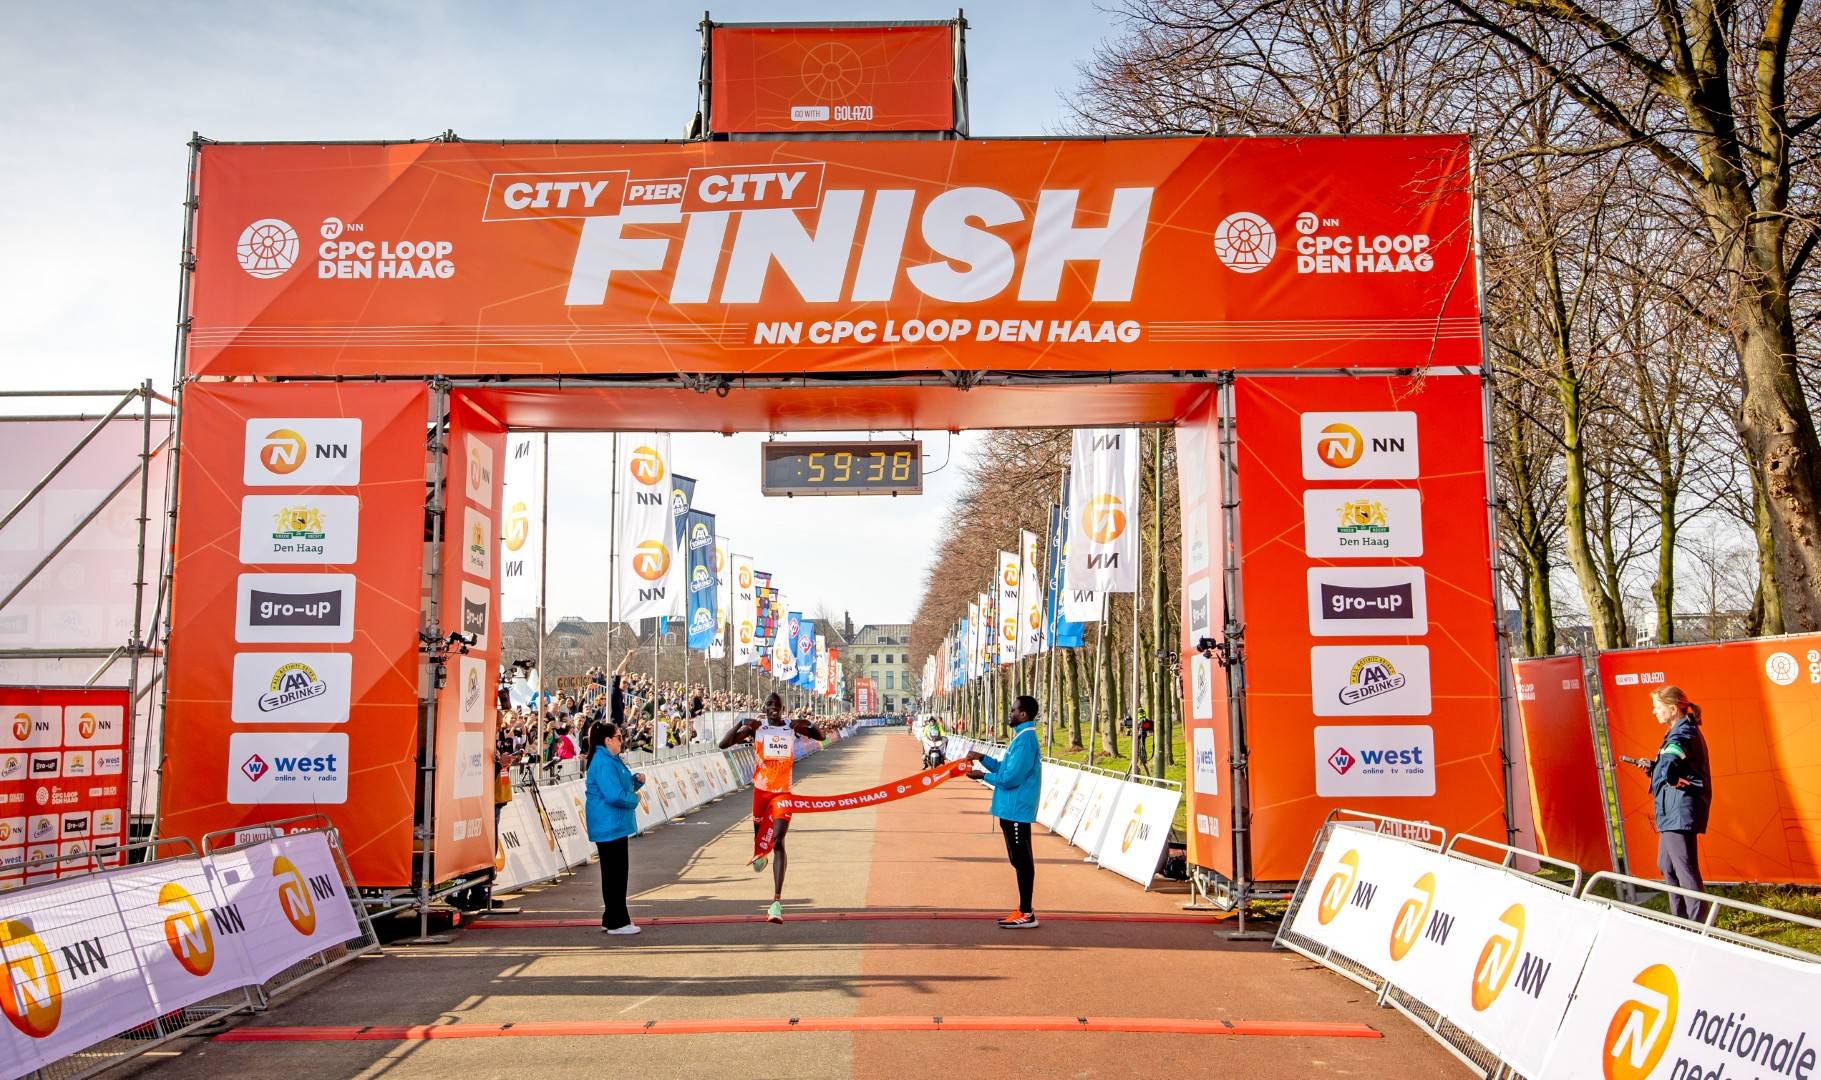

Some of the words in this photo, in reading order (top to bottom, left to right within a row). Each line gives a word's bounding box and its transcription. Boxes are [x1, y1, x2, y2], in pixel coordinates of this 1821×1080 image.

[834, 105, 873, 121] GOLAZO
[503, 180, 609, 211] CITY
[629, 184, 682, 201] PIER
[698, 171, 807, 203] CITY
[347, 223, 364, 232] NN
[1322, 218, 1339, 227] NN
[319, 241, 376, 260] CPC
[381, 241, 453, 260] LOOP
[564, 186, 1154, 305] FINISH
[1296, 236, 1353, 255] CPC
[1358, 235, 1430, 254] LOOP
[318, 260, 372, 279] DEN
[378, 260, 456, 279] HAAG
[1297, 255, 1351, 274] DEN
[1356, 253, 1434, 272] HAAG
[753, 321, 804, 345] NN
[809, 320, 877, 345] CPC
[882, 320, 972, 345] LOOP
[977, 320, 1045, 345] DEN
[1047, 320, 1142, 345] HAAG
[316, 443, 348, 459] NN
[1372, 438, 1405, 453] NN
[636, 491, 663, 505] NN
[274, 543, 294, 553] Den
[297, 543, 324, 555] Haag
[1340, 536, 1360, 546] Den
[1362, 536, 1390, 548] Haag
[640, 586, 665, 601] NN
[1005, 590, 1018, 598] NN
[260, 600, 331, 618] gro-up
[1331, 594, 1403, 612] gro-up
[285, 673, 309, 692] AA
[1364, 666, 1388, 686] AA
[280, 686, 315, 704] DRINK
[1359, 679, 1394, 697] DRINK
[36, 721, 49, 732] NN
[98, 720, 111, 730] NN
[274, 754, 337, 772] west
[1360, 746, 1422, 765] west
[275, 774, 296, 782] online
[318, 774, 338, 782] radio
[1363, 767, 1384, 775] online
[1405, 767, 1424, 775] radio
[777, 799, 792, 808] NN
[793, 800, 810, 808] CPC
[811, 800, 836, 808] LOOP
[838, 797, 858, 806] DEN
[859, 791, 888, 802] HAAG
[240, 833, 250, 844] GO
[502, 831, 520, 849] NN
[1137, 822, 1152, 841] NN
[309, 874, 335, 902] NN
[1351, 881, 1377, 910] NN
[210, 903, 245, 936] NN
[1426, 910, 1455, 945] NN
[60, 937, 109, 980] NN
[1515, 951, 1551, 999] NN
[1688, 1009, 1816, 1080] nationale
